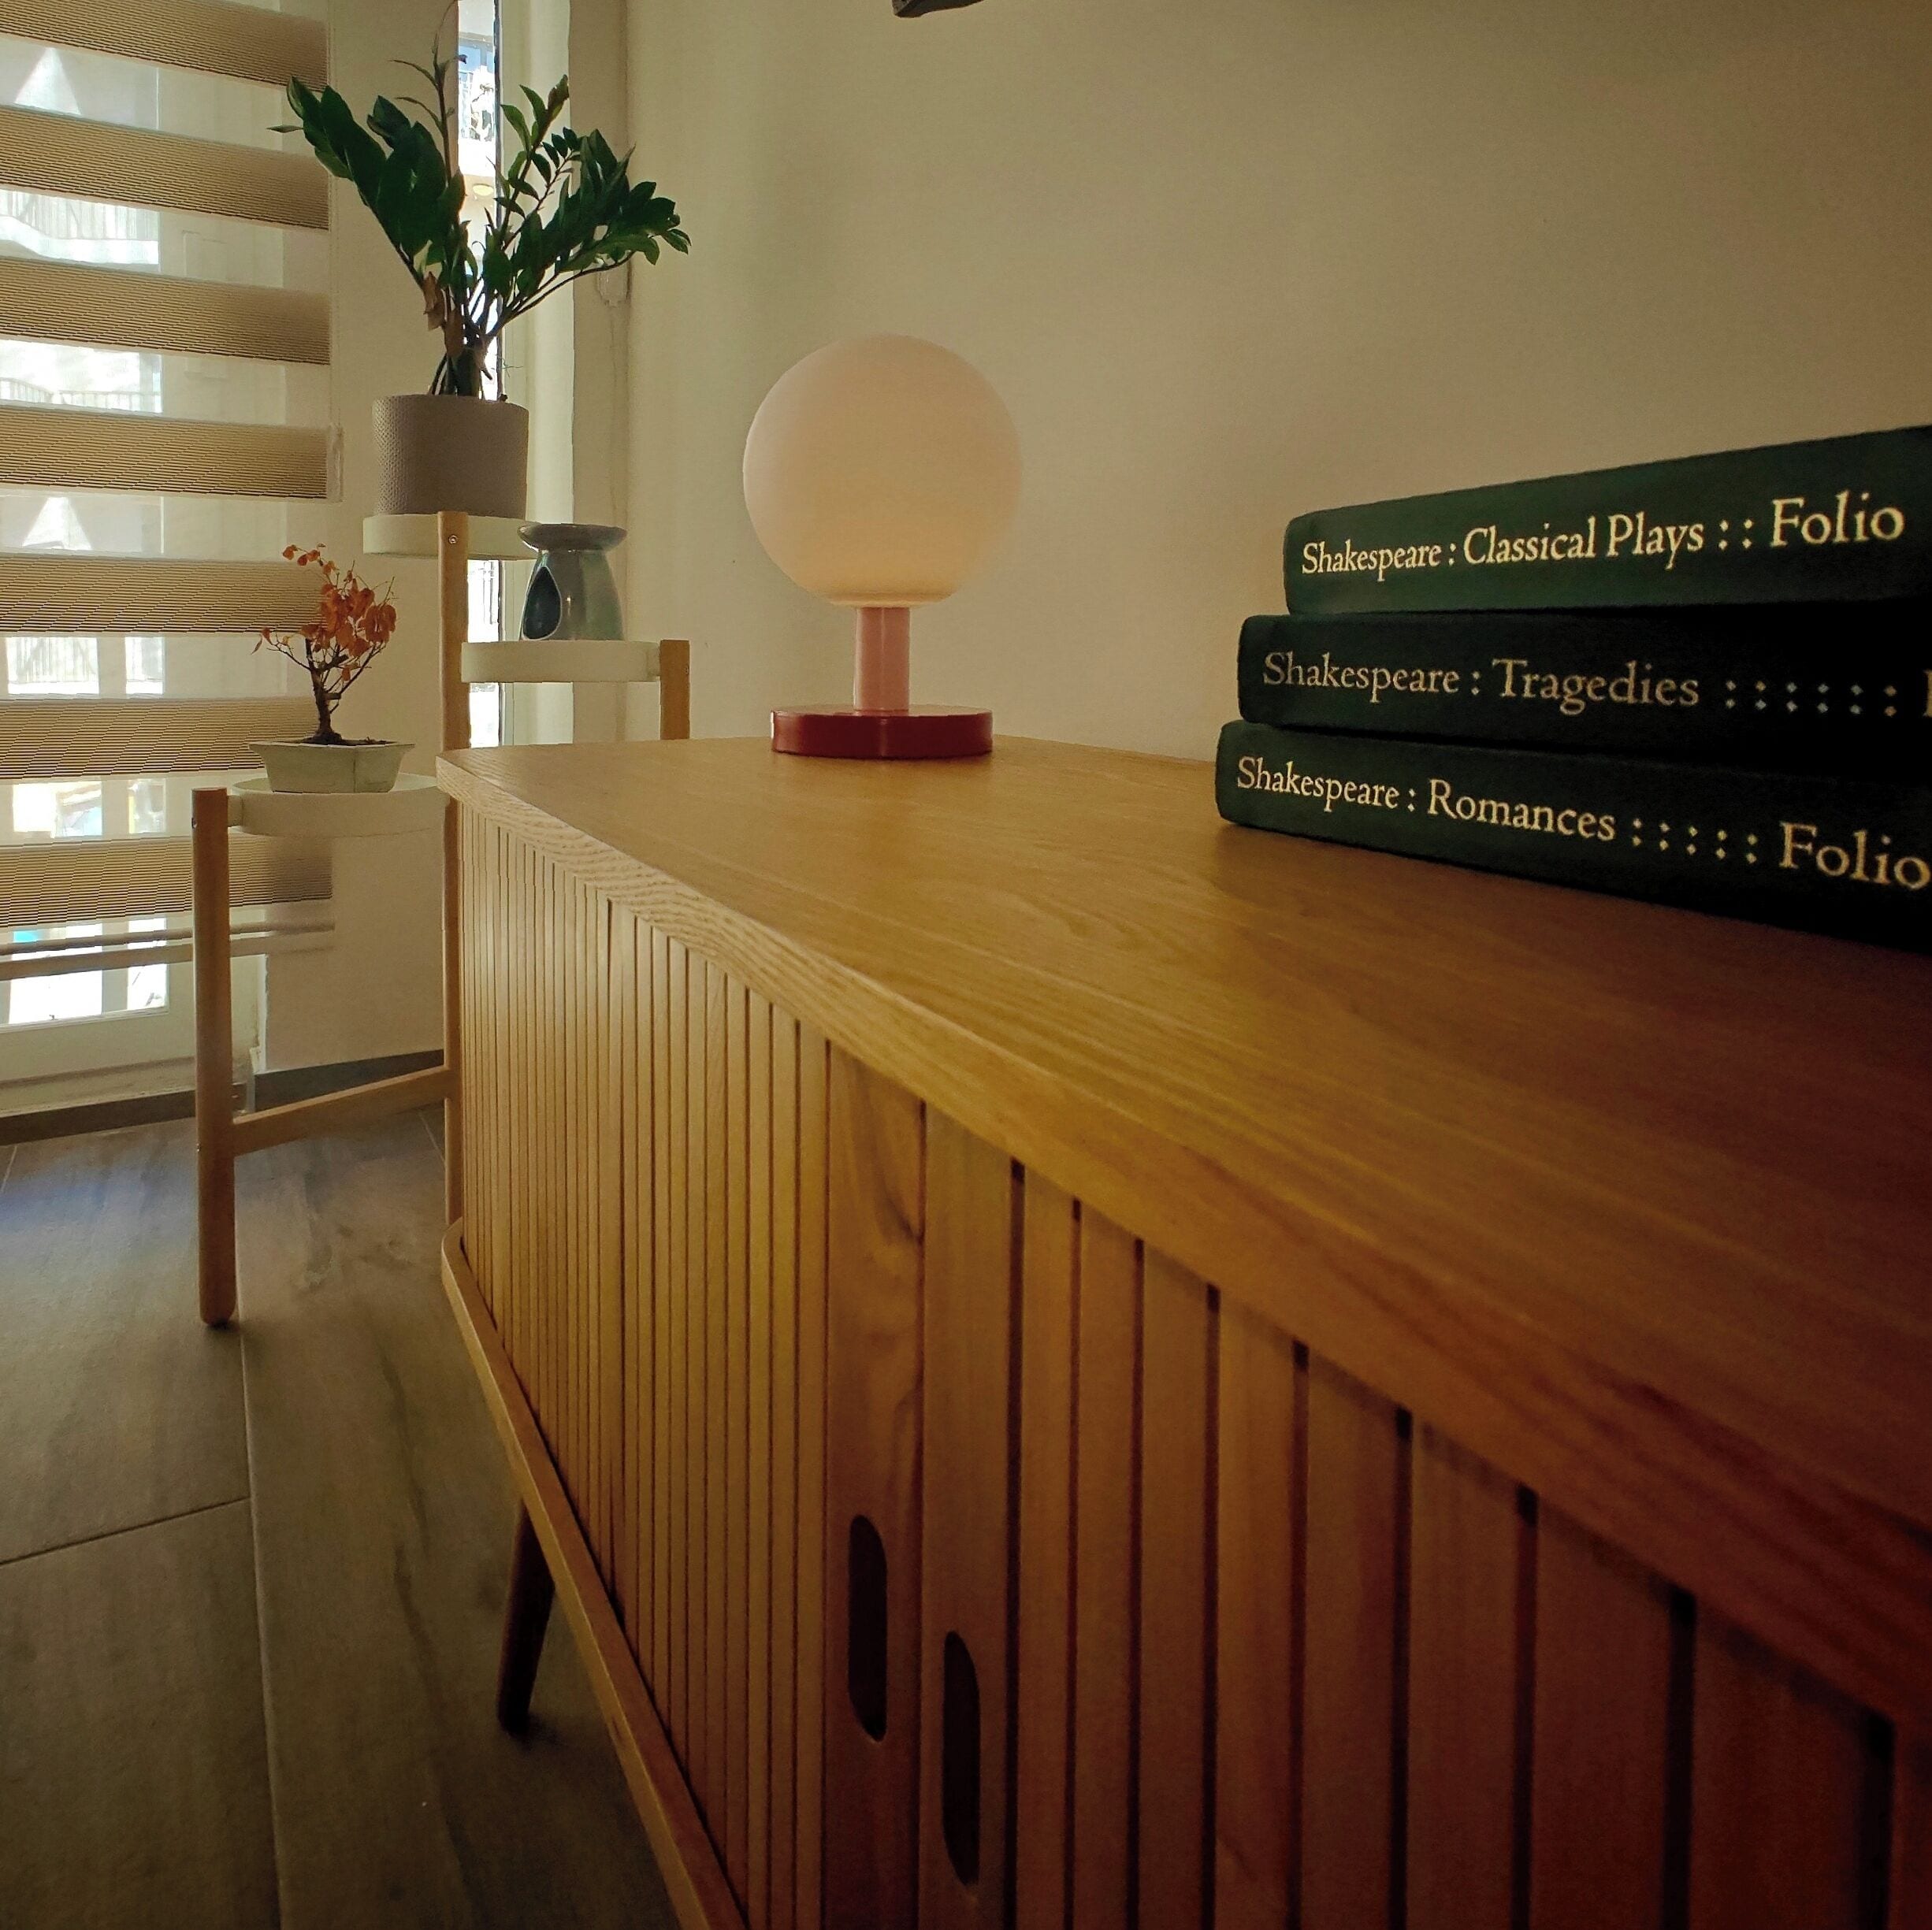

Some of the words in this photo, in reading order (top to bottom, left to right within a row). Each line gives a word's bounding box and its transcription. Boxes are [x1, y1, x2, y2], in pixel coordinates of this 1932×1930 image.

[1301, 538, 1443, 582] Shakespeare
[1462, 515, 1597, 565] Classical
[1605, 510, 1705, 570] Plays
[1770, 489, 1905, 548] Folio
[1262, 651, 1460, 703] Shakespeare
[1492, 658, 1700, 716] Tragedies
[1236, 755, 1400, 813] Shakespeare
[1427, 778, 1616, 842] Romances
[1778, 821, 1931, 890] Folio
